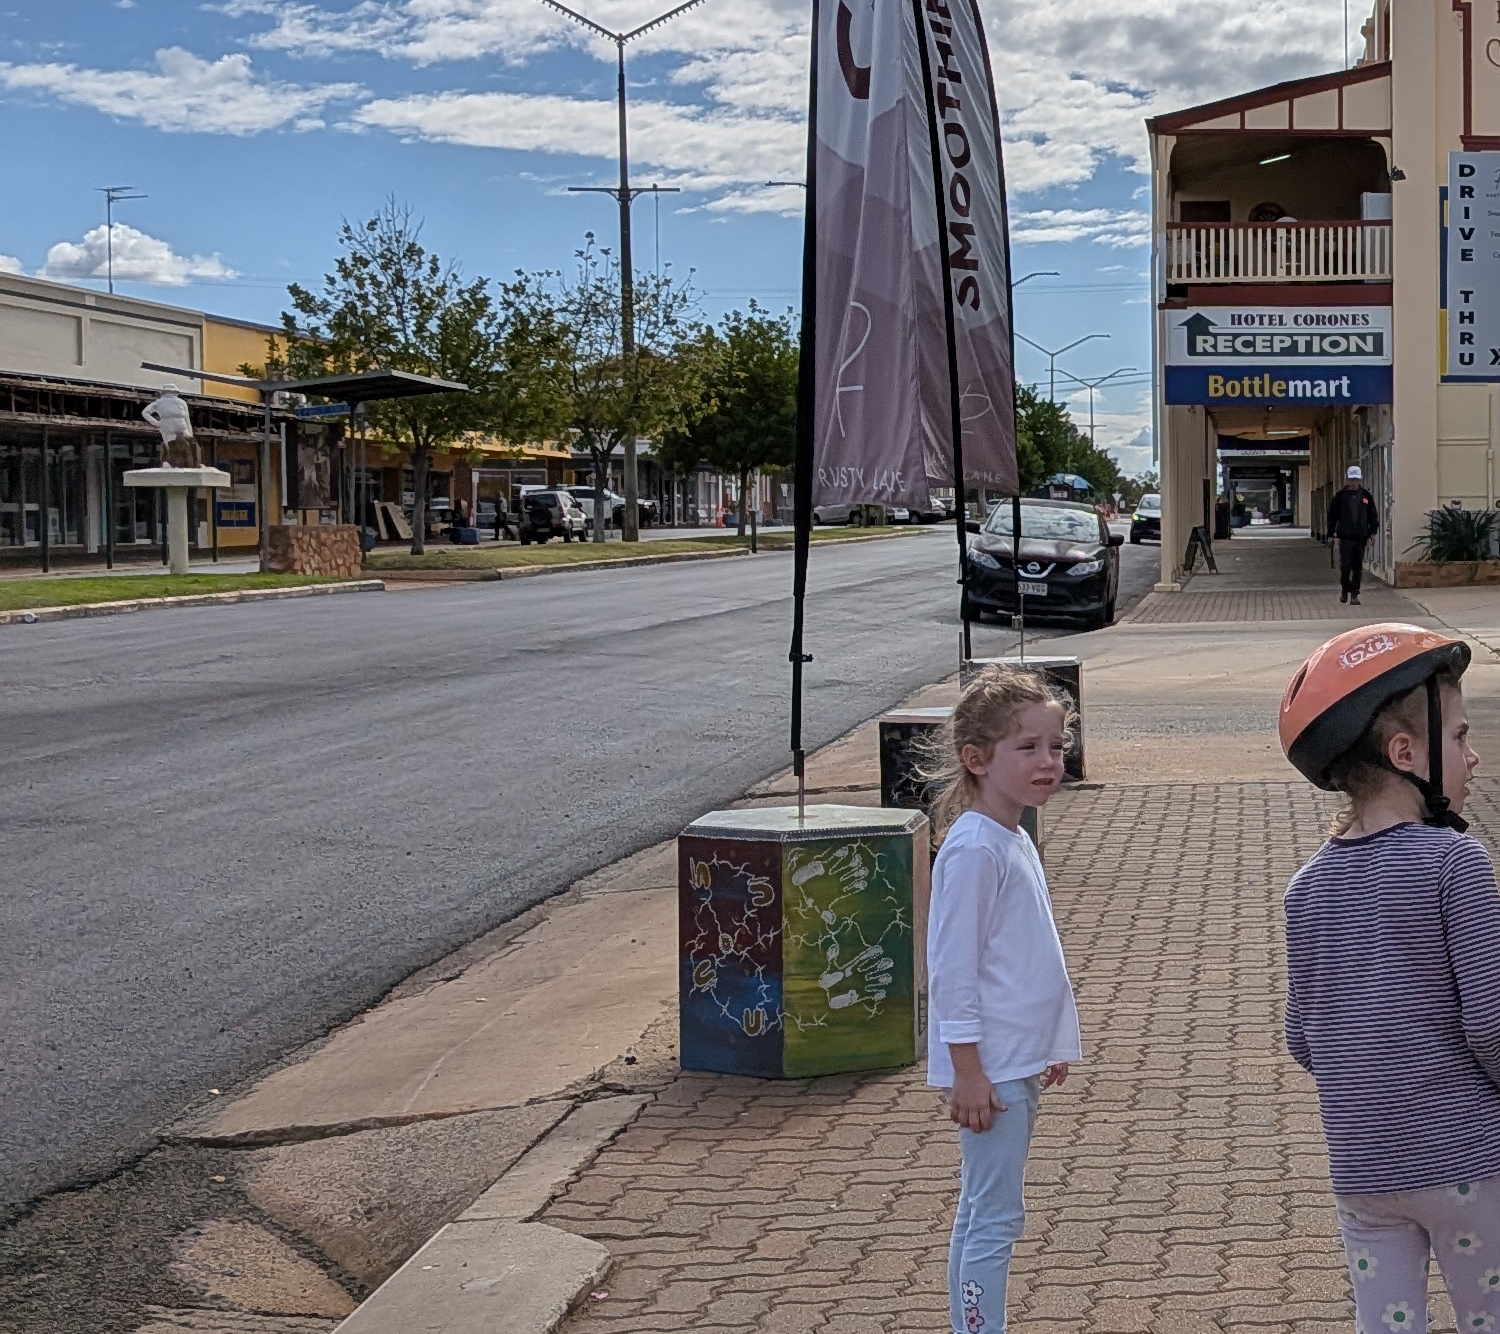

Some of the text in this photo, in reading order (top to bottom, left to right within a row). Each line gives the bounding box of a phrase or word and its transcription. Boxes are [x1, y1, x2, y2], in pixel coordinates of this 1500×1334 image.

[1458, 164, 1476, 366] DRIVE THRU
[1230, 313, 1370, 326] HOTEL CORONES
[1195, 335, 1374, 353] RECEPTION
[1208, 373, 1351, 398] Bottlemart
[818, 467, 865, 489] RUSTY
[964, 470, 1002, 483] LANE
